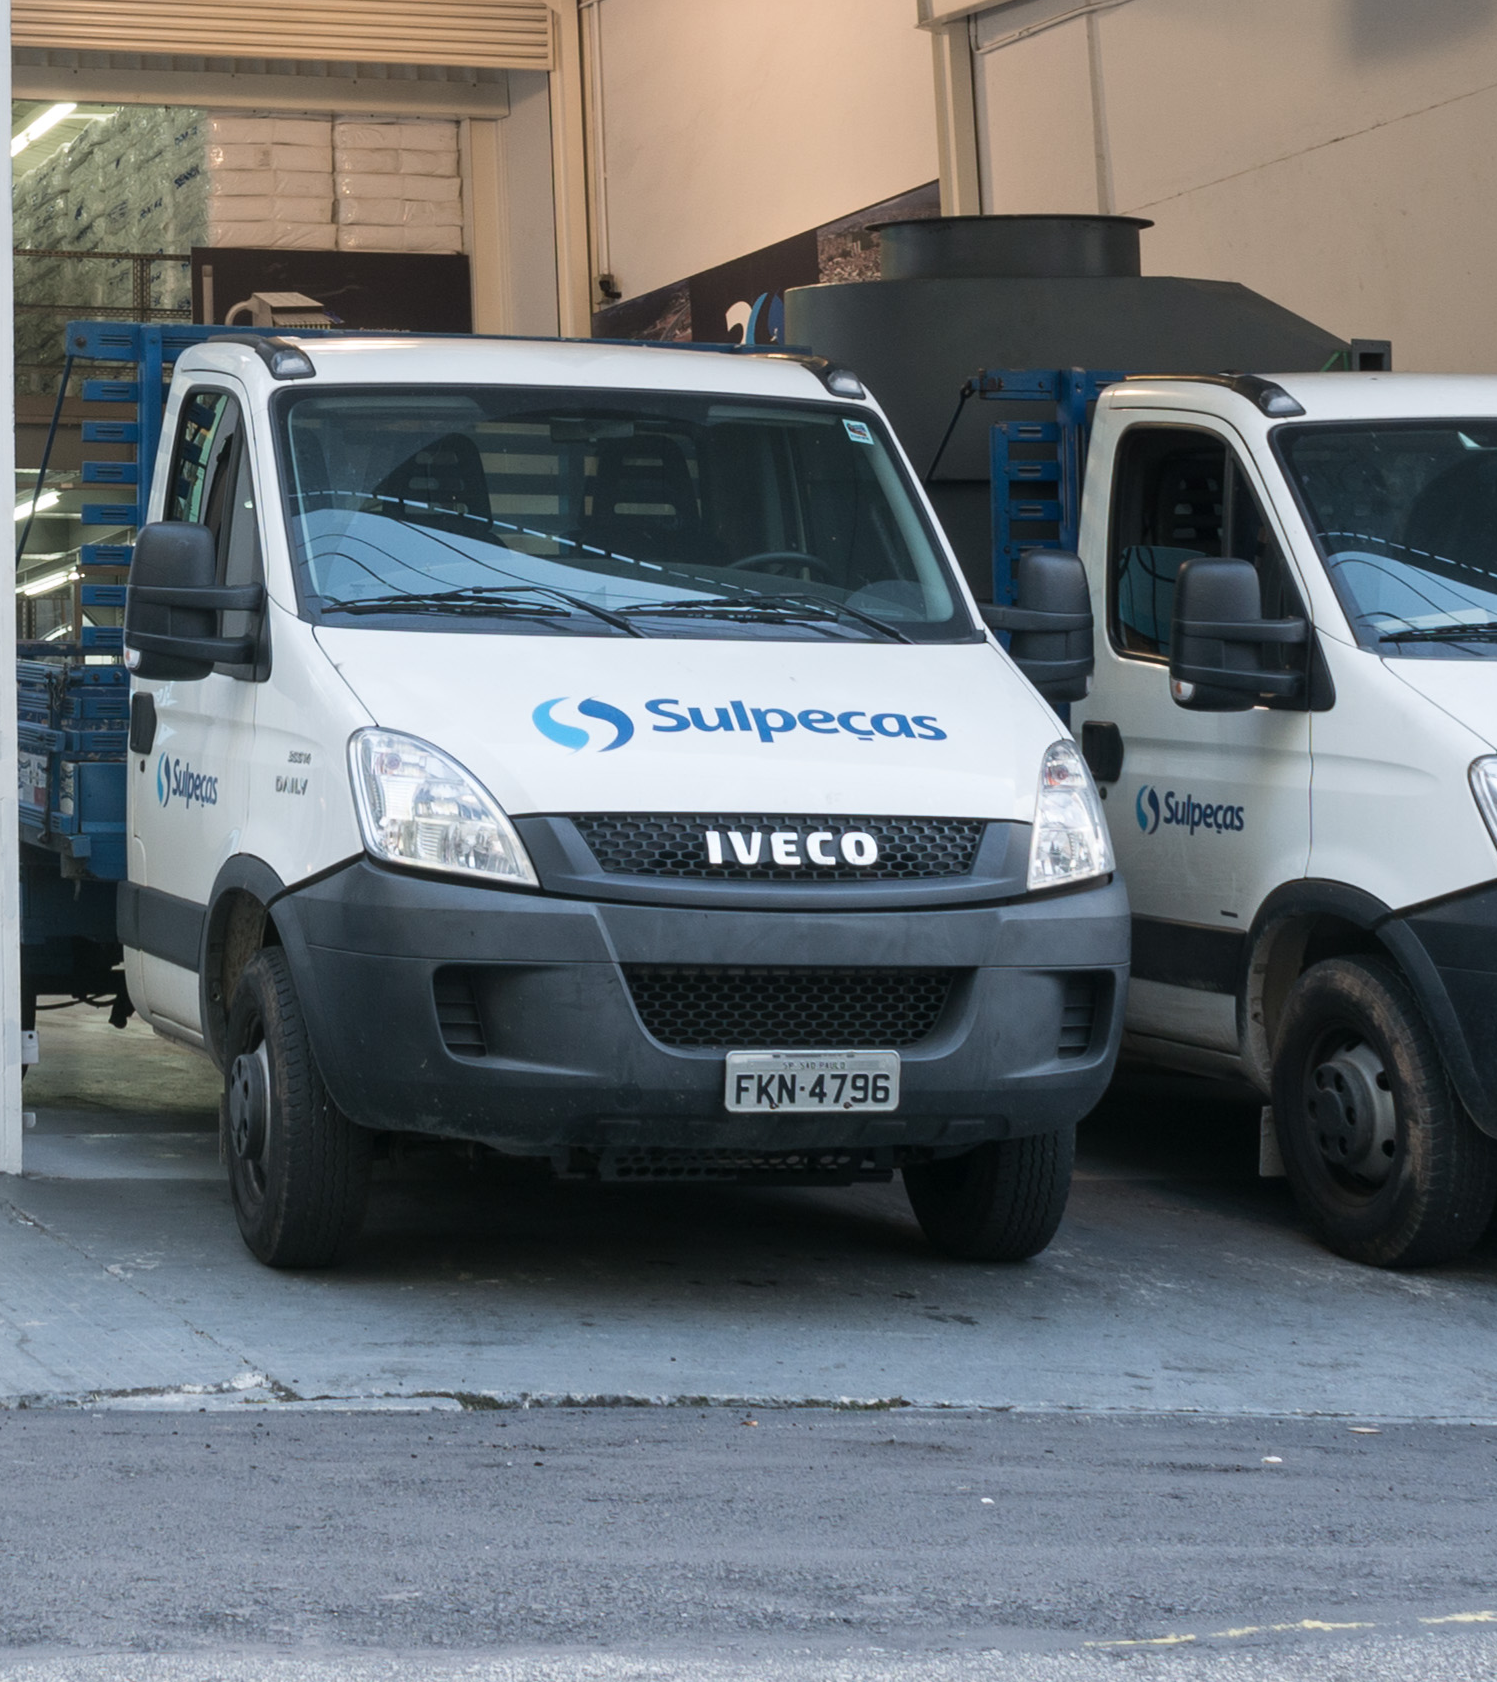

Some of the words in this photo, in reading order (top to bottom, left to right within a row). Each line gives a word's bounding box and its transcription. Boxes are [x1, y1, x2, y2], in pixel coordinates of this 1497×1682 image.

[644, 698, 947, 743] Sulpeças
[172, 758, 218, 809] Sulpeças
[275, 775, 308, 796] DAILY
[1163, 791, 1244, 836] Sulpeças
[705, 830, 879, 866] IVECO
